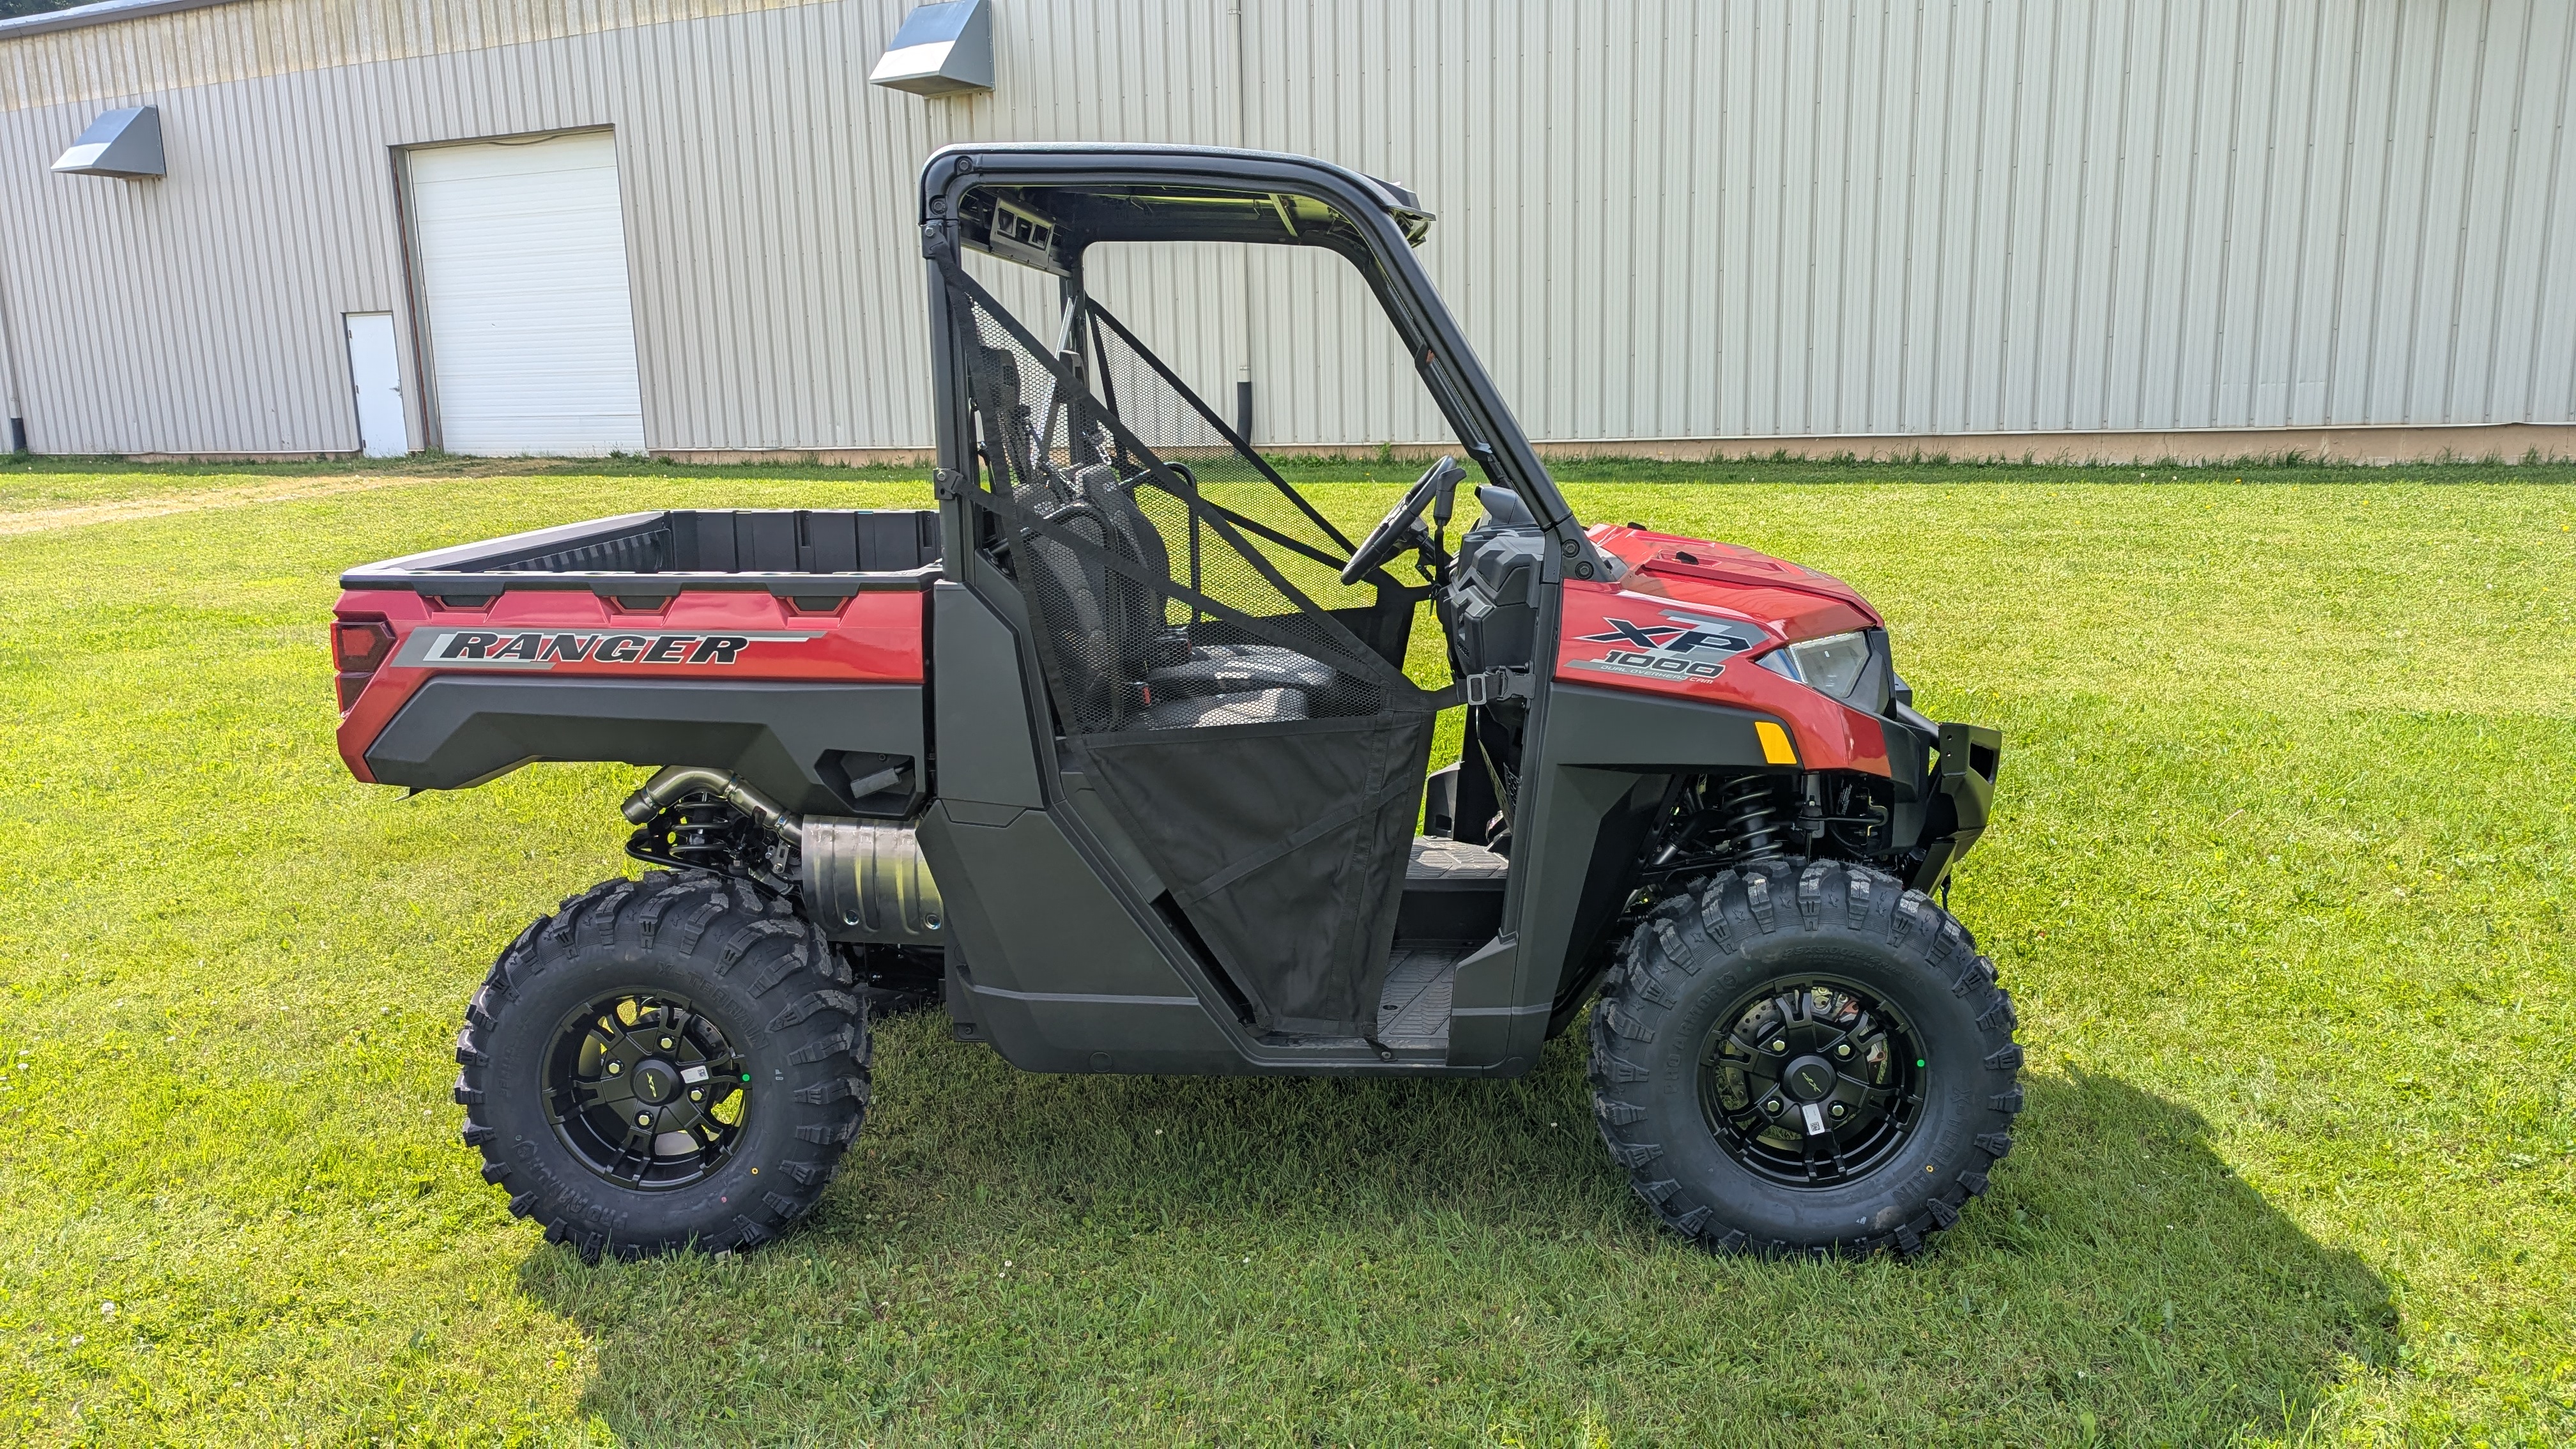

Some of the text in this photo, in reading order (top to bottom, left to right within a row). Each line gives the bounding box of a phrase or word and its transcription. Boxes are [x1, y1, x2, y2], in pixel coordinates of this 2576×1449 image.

[438, 631, 749, 664] RANGER
[1571, 617, 1752, 654] XP
[1600, 664, 1714, 685] DUAL OVERHEAD CAM
[1603, 649, 1726, 678] 1000
[656, 960, 769, 1050] X-TERRAIN
[1664, 985, 1724, 1094] PRO ARMOR
[1890, 1086, 1972, 1208] X-TERRAIN
